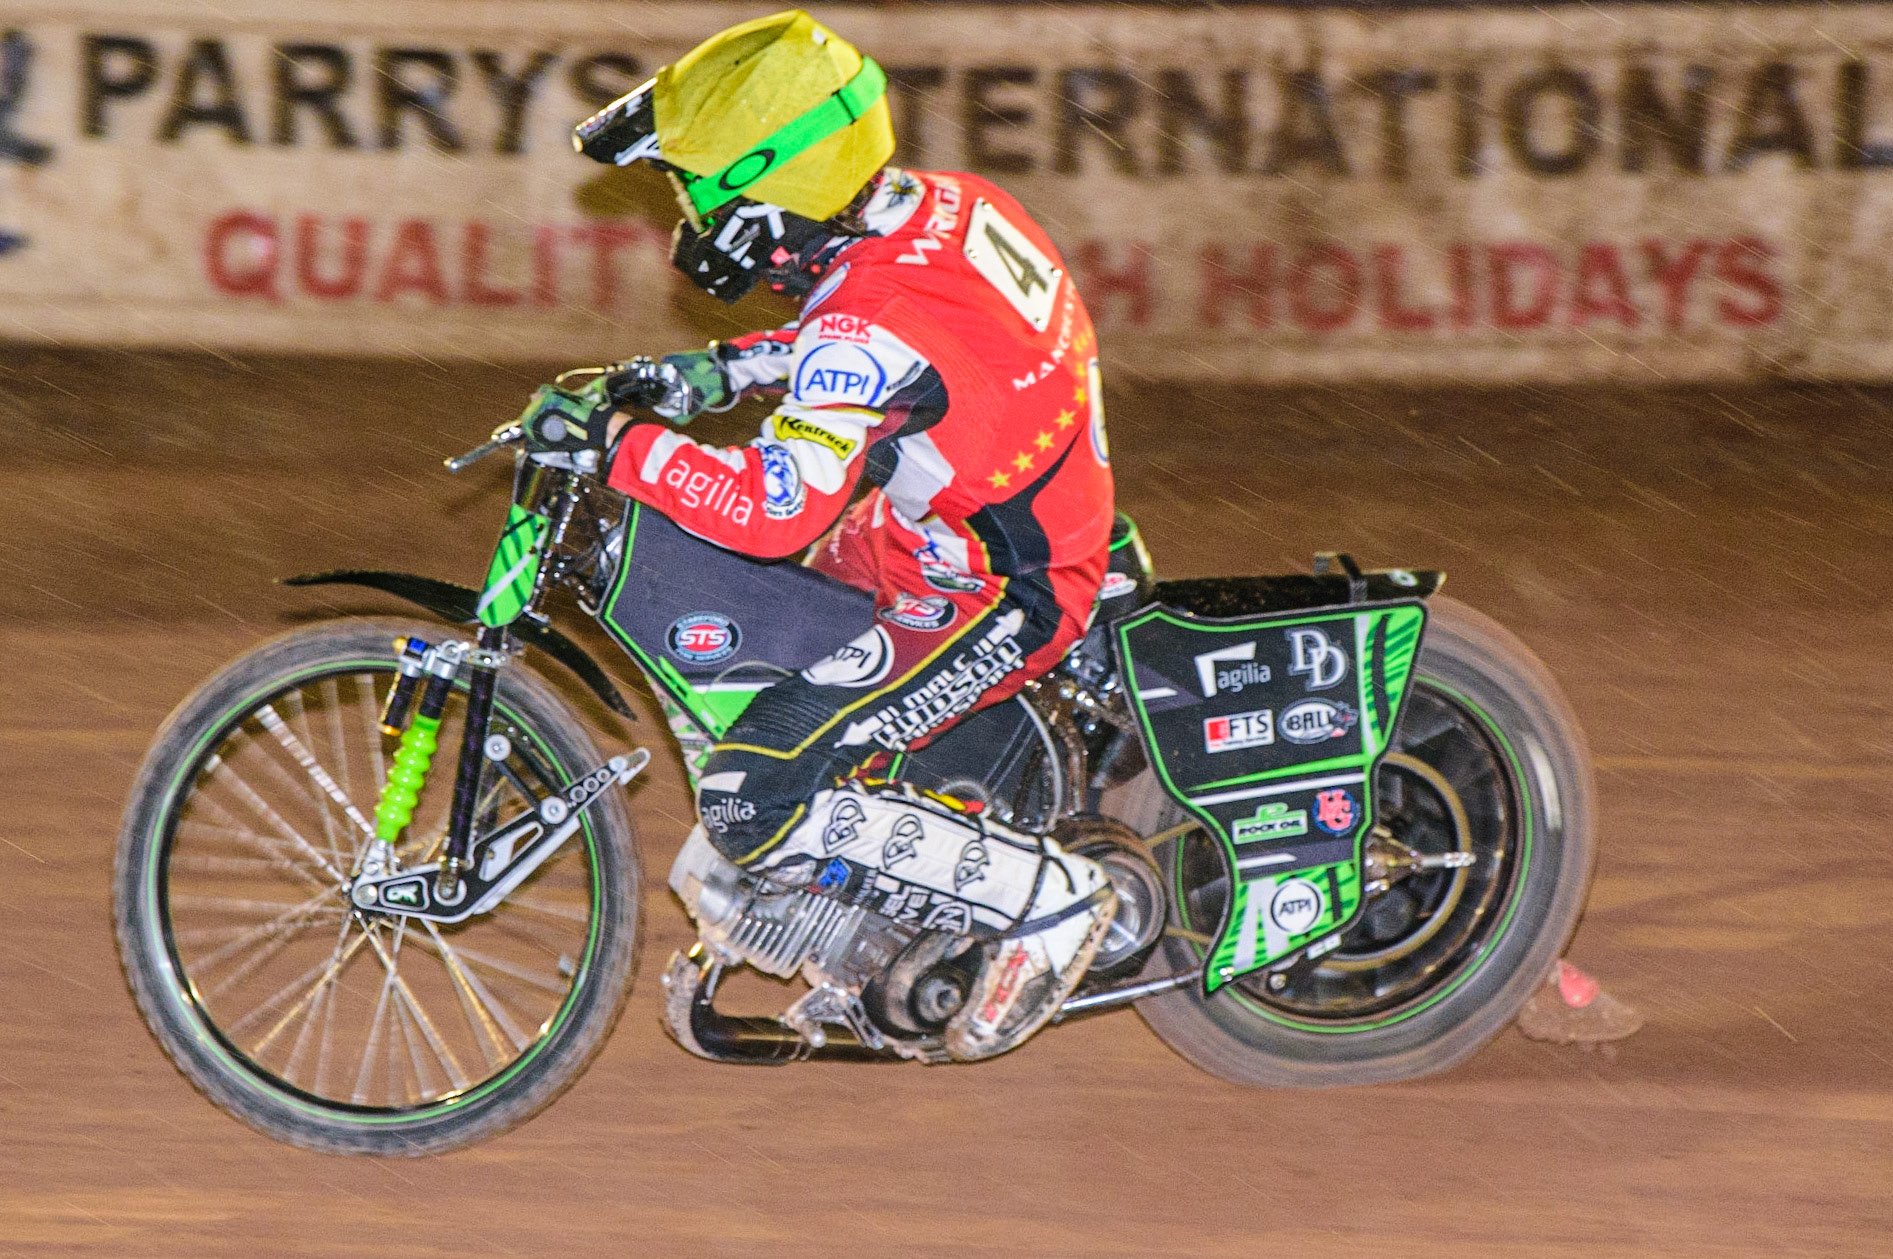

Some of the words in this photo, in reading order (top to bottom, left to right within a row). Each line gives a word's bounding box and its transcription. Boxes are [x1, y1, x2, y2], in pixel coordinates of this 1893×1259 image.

[886, 58, 1893, 178] TERNATIONAL
[203, 208, 674, 312] QUALIT
[984, 222, 1048, 297] 4
[1198, 236, 1787, 332] HOLIDAYS
[820, 316, 871, 338] NGK
[805, 368, 870, 396] ATPI
[666, 460, 753, 526] agilia
[679, 628, 730, 646] STS
[1217, 661, 1272, 693] agilia
[1229, 713, 1269, 738] FTS
[701, 797, 757, 833] agilia
[1279, 898, 1313, 918] ATPI
